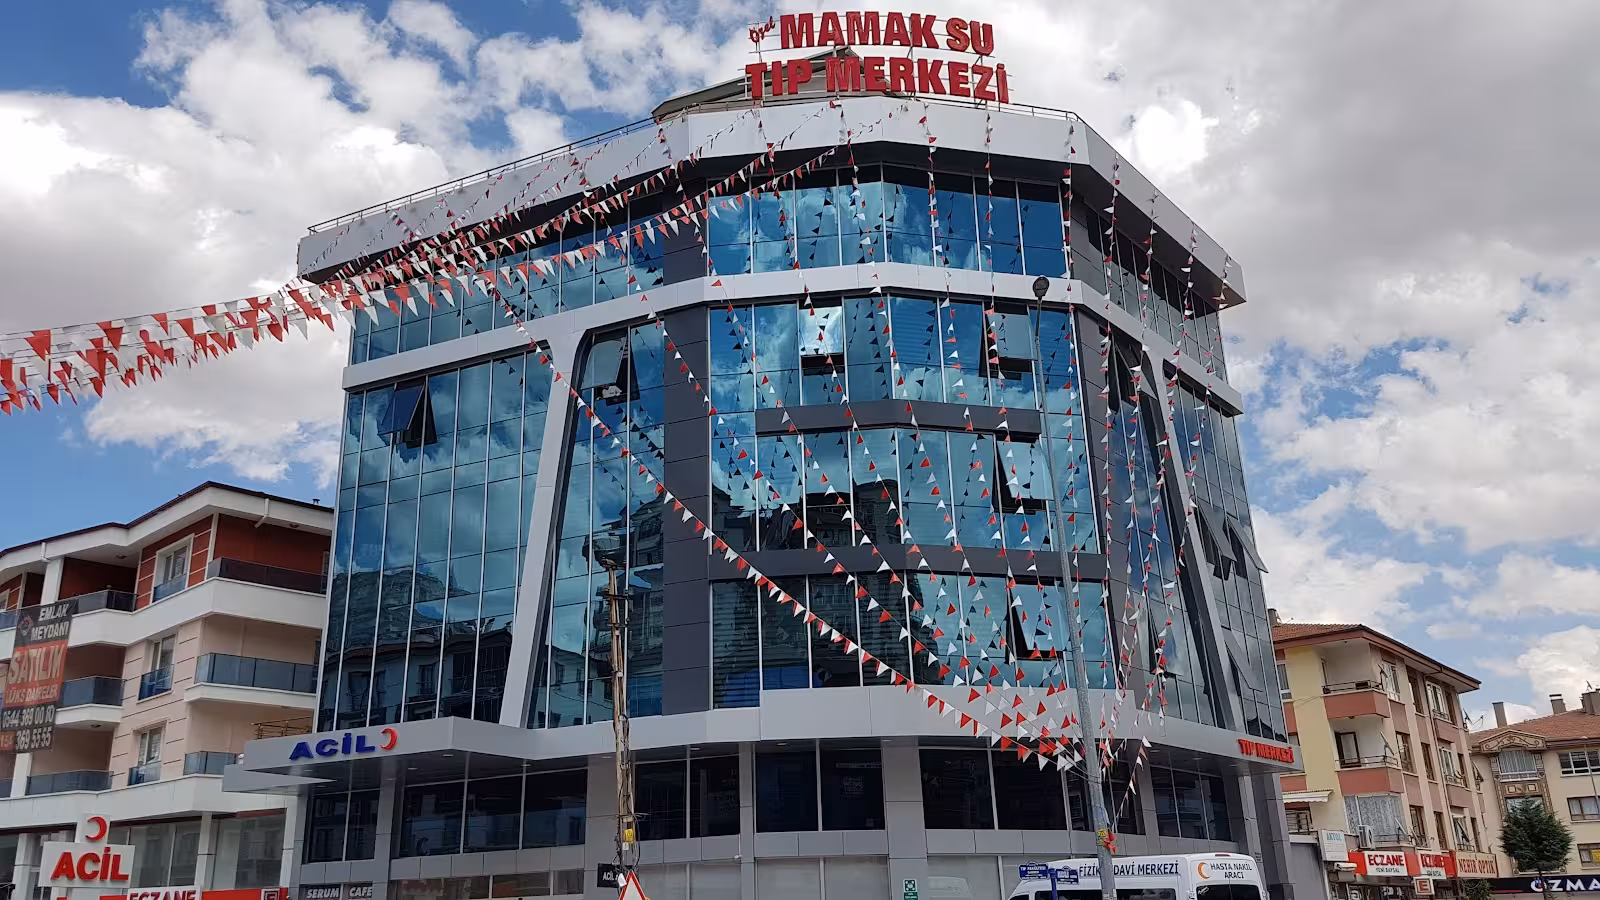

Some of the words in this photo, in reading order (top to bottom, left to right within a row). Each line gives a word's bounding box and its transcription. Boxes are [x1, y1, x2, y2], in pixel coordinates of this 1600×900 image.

[780, 11, 939, 49] MAMAK
[946, 17, 994, 56] SU
[745, 59, 813, 100] TIP
[825, 56, 1009, 104] MERKEZİ
[38, 603, 70, 621] EMLAK
[30, 621, 70, 641] MEYDANI
[7, 644, 65, 683] SATILIK
[289, 732, 376, 761] ACİL
[1237, 739, 1255, 755] TIP
[1255, 743, 1294, 763] MERKEZİ
[50, 846, 130, 882] ACİL
[1113, 861, 1135, 876] DAVİ
[1137, 859, 1179, 875] MERKEZİ
[1210, 862, 1233, 871] HASTA
[1367, 854, 1405, 867] ECZANE
[306, 887, 339, 899] SERUM
[349, 886, 373, 897] CAFE
